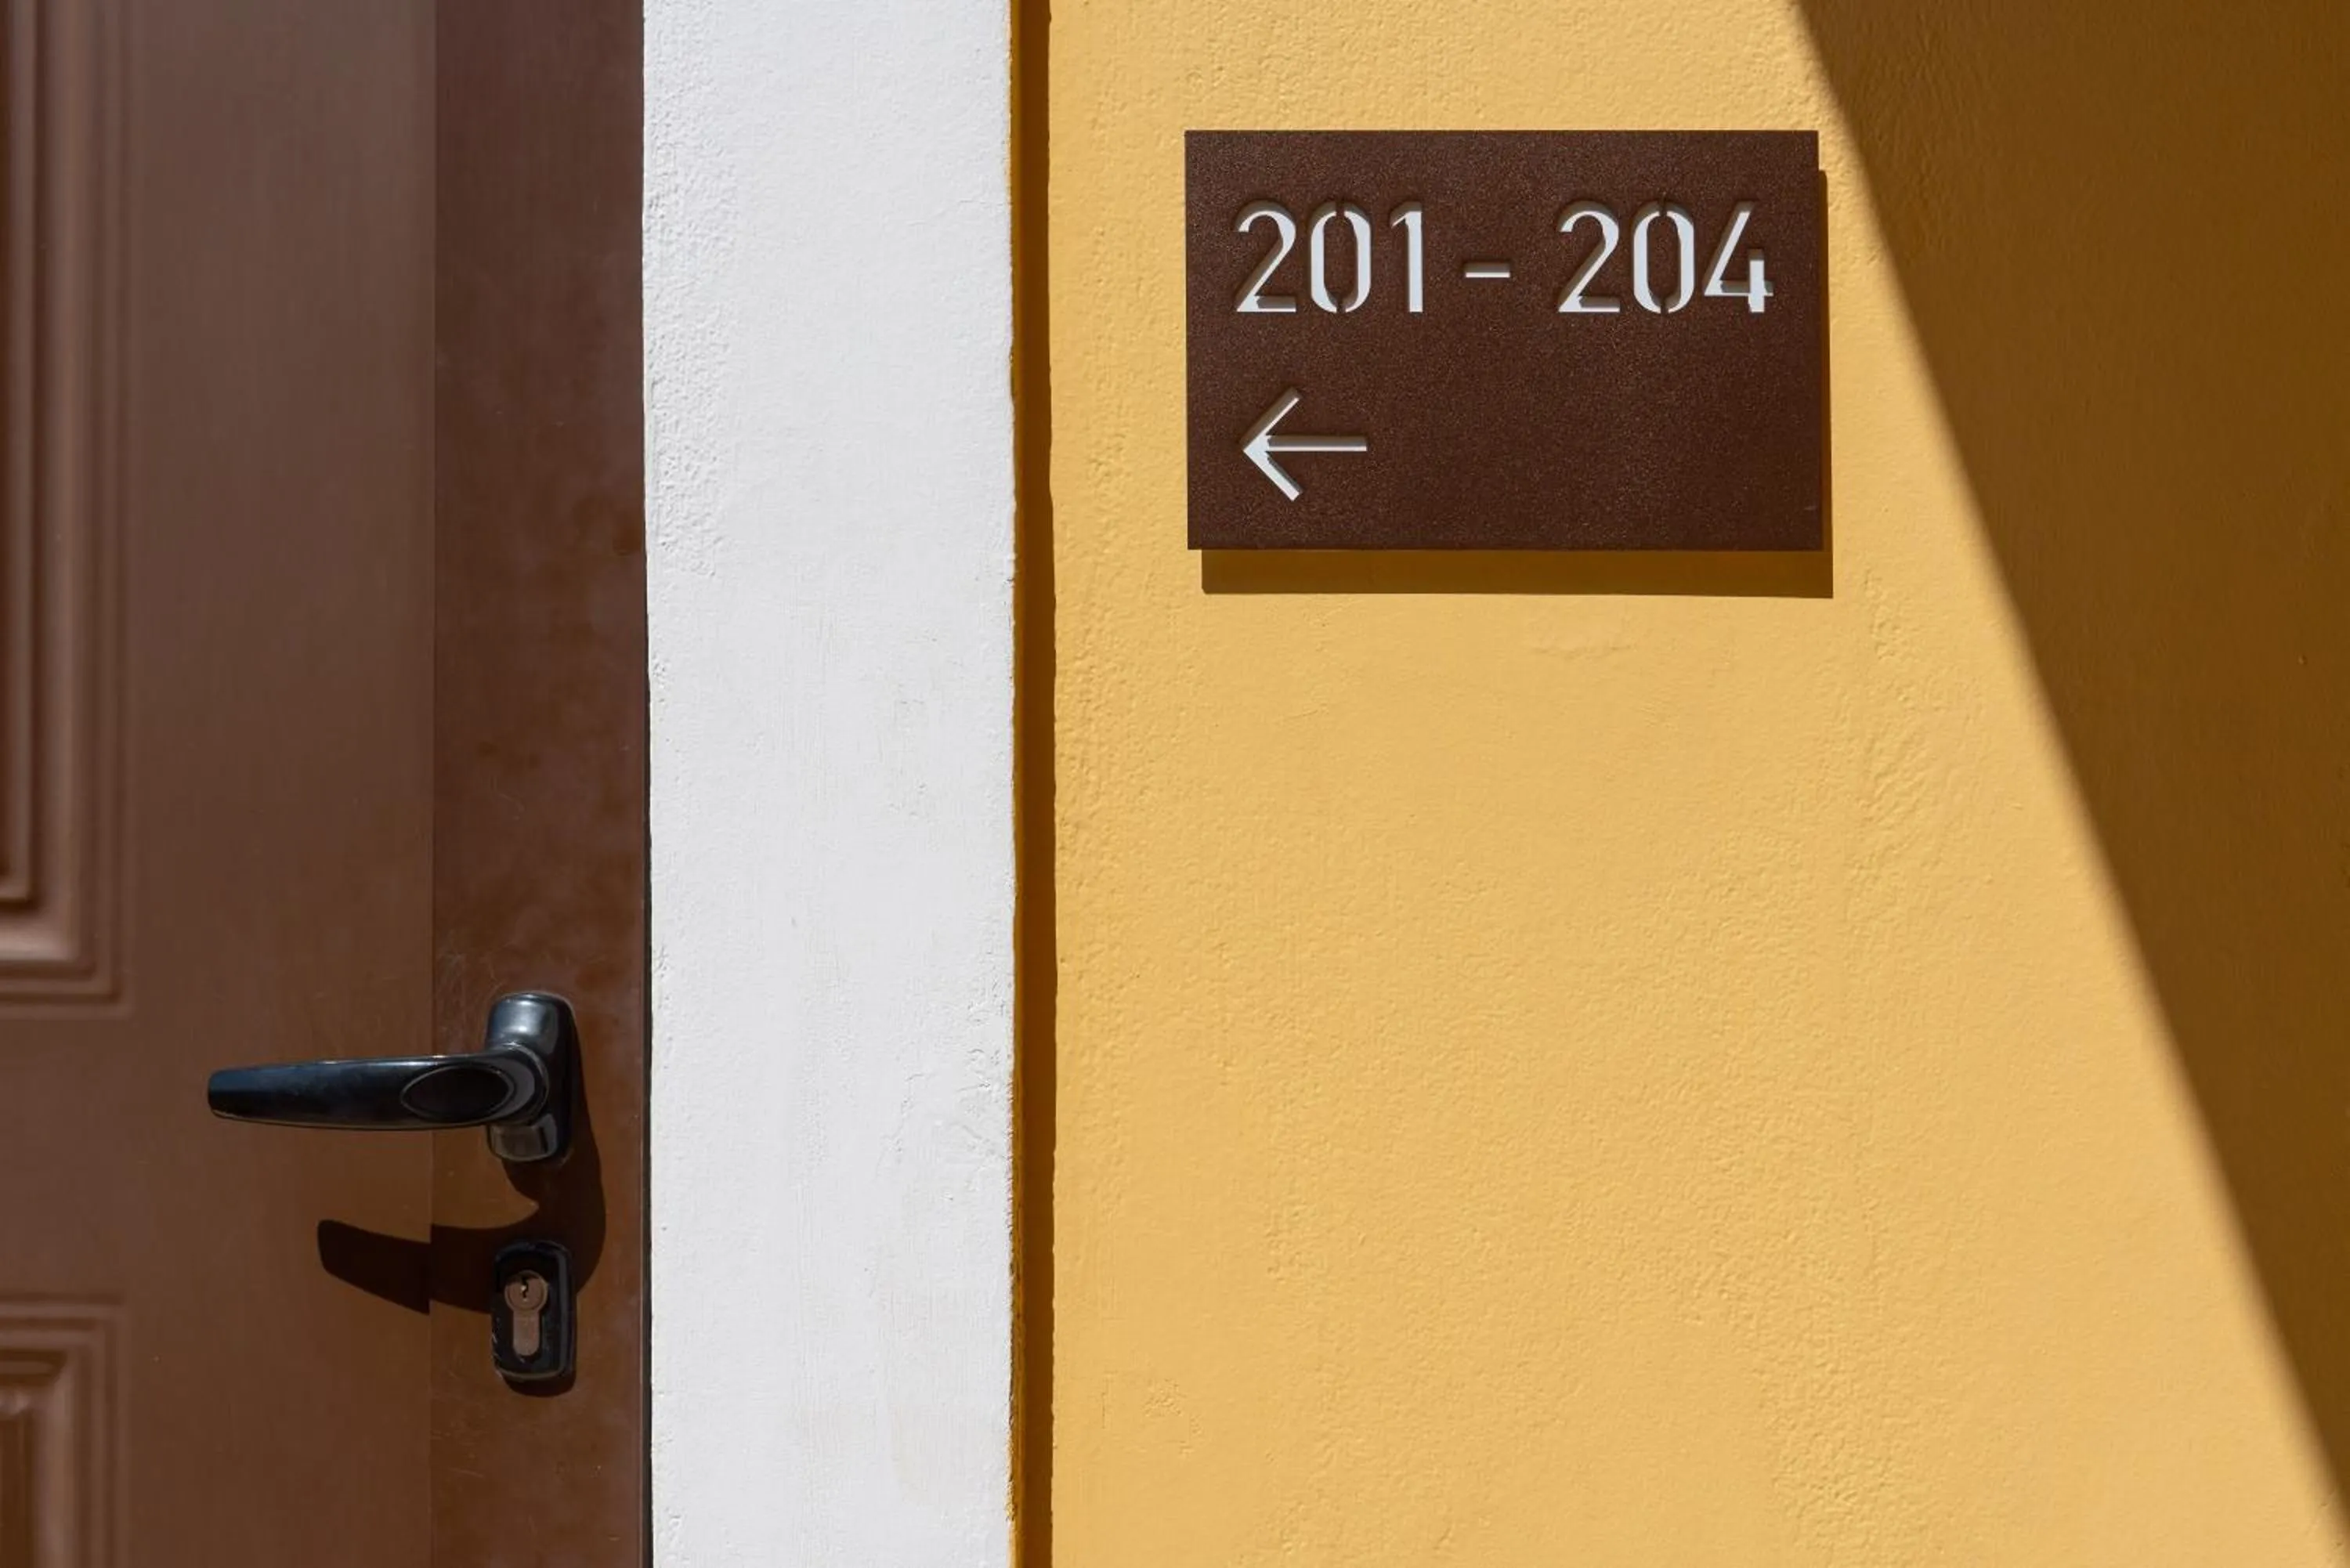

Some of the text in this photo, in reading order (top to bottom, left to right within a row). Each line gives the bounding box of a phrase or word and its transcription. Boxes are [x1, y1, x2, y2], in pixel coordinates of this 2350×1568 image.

[1235, 203, 1774, 313] 201 - 204
